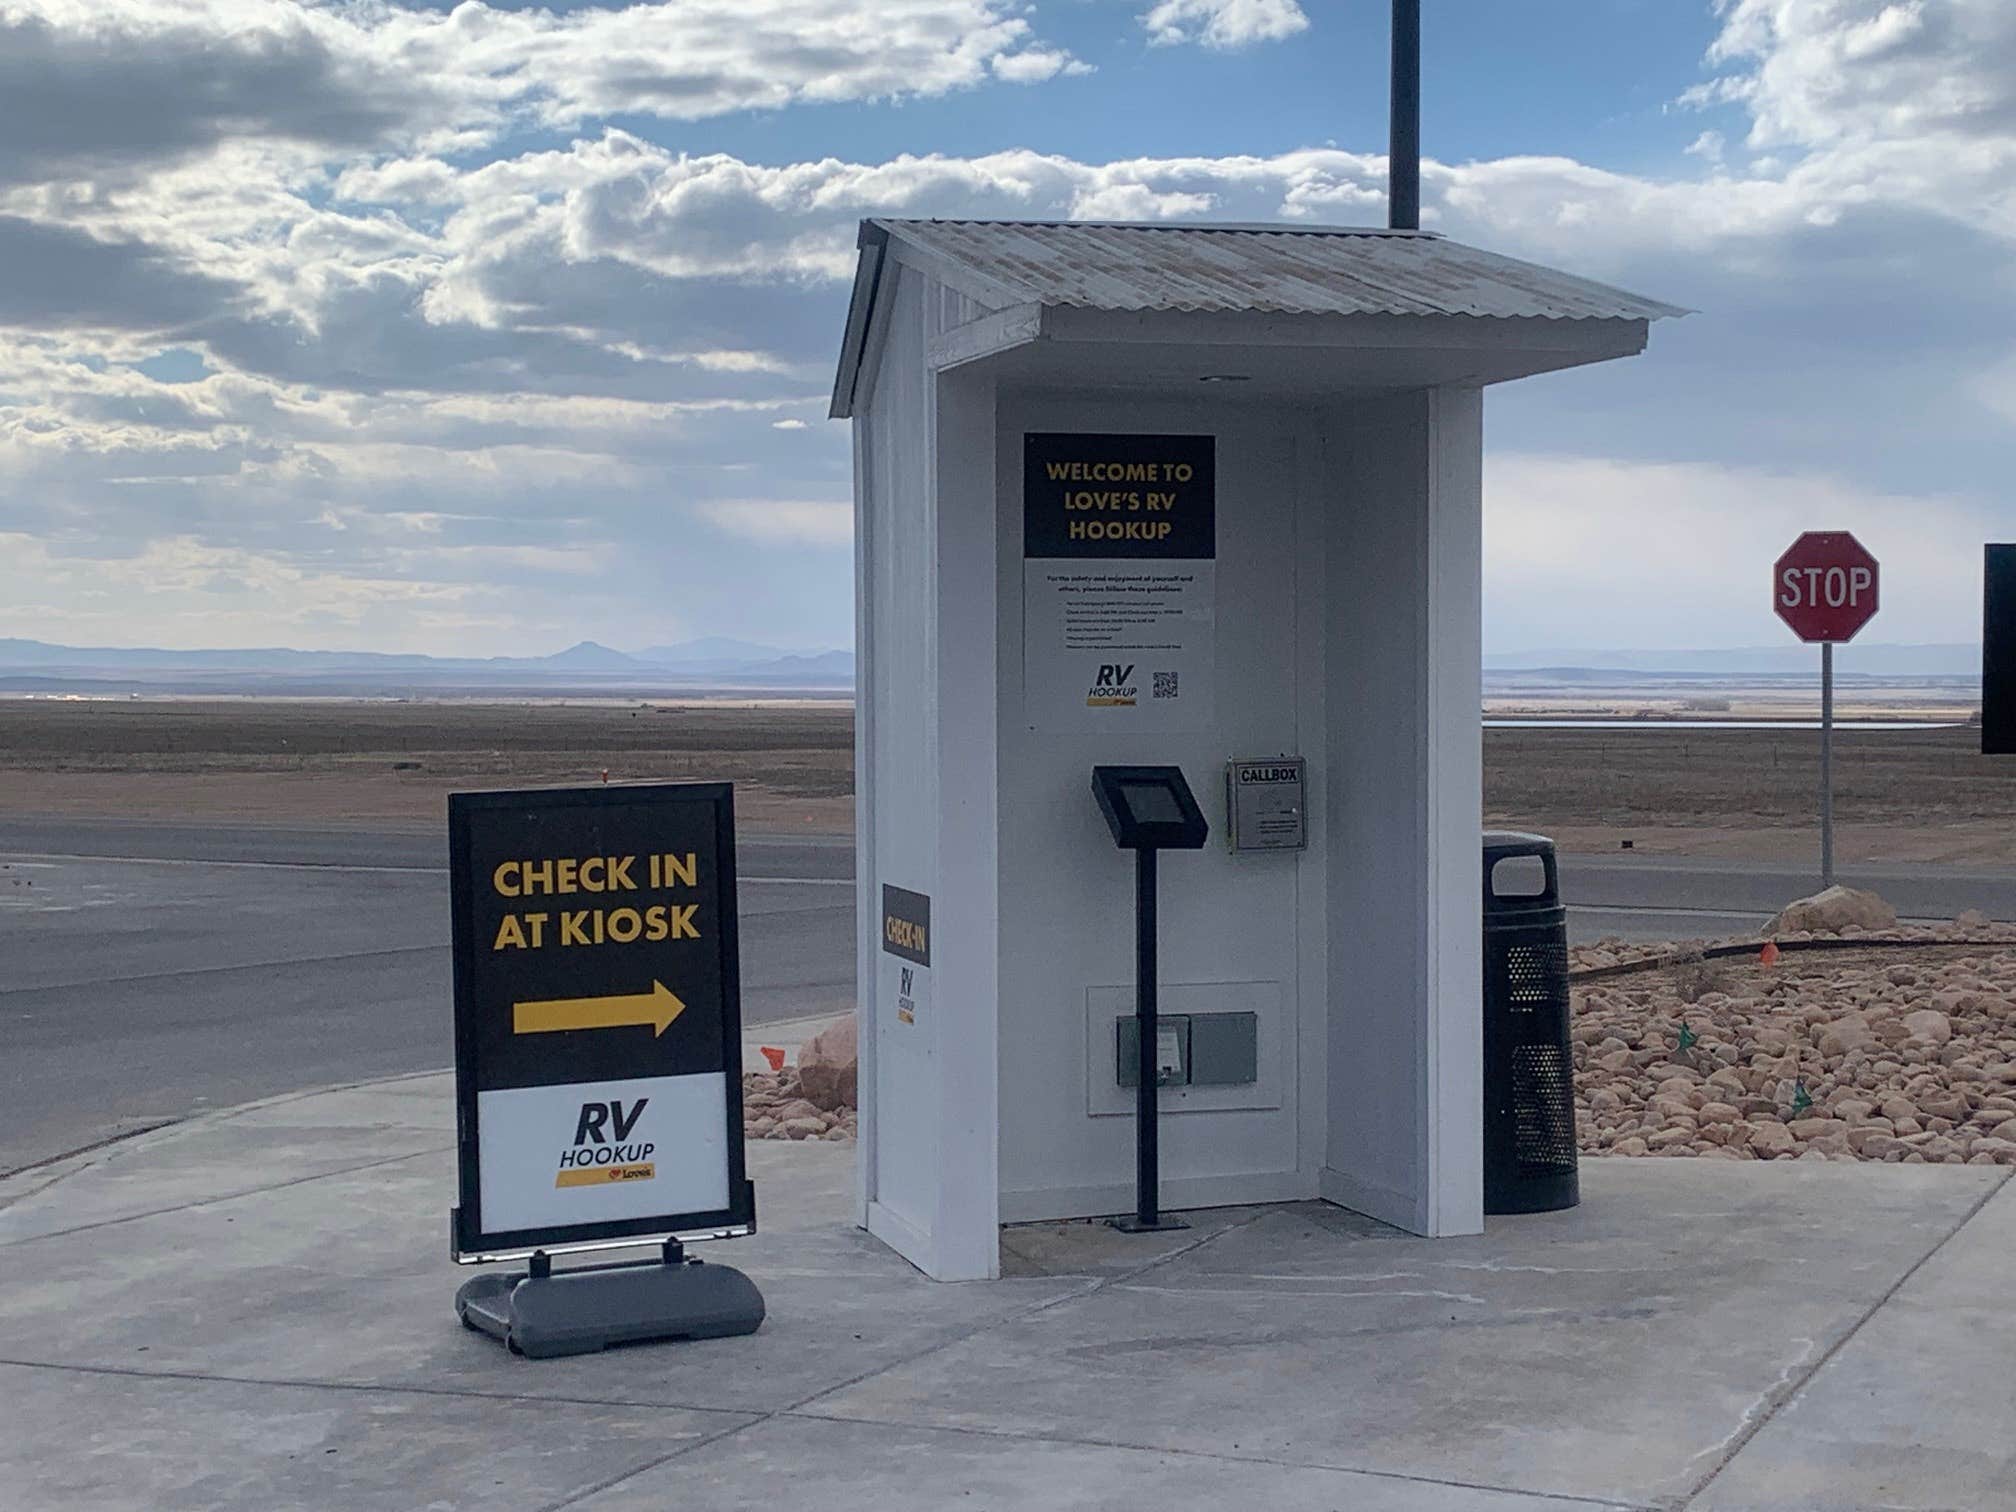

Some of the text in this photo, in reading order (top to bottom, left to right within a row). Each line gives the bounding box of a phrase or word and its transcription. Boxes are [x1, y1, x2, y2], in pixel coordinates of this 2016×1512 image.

[1046, 462, 1193, 482] WELCOME TO
[1064, 492, 1176, 511] LOVE'S RV
[1070, 521, 1172, 540] HOOKUP
[1071, 575, 1092, 583] safety
[1107, 575, 1142, 583] enjoyment
[1152, 575, 1179, 583] yourself
[1180, 575, 1193, 583] and
[1082, 586, 1104, 594] please
[1105, 585, 1126, 593] follow
[1128, 585, 1145, 593] these
[1781, 566, 1872, 607] STOP
[1096, 664, 1135, 686] RV
[1088, 687, 1137, 697] HOOKUP
[1241, 768, 1297, 782] CALLBOX
[493, 852, 697, 898] CHECK IN
[493, 904, 701, 950] AT KIOSK
[886, 915, 926, 953] CHECK-IN
[574, 1098, 650, 1146] RV
[560, 1143, 655, 1168] HOOKUP
